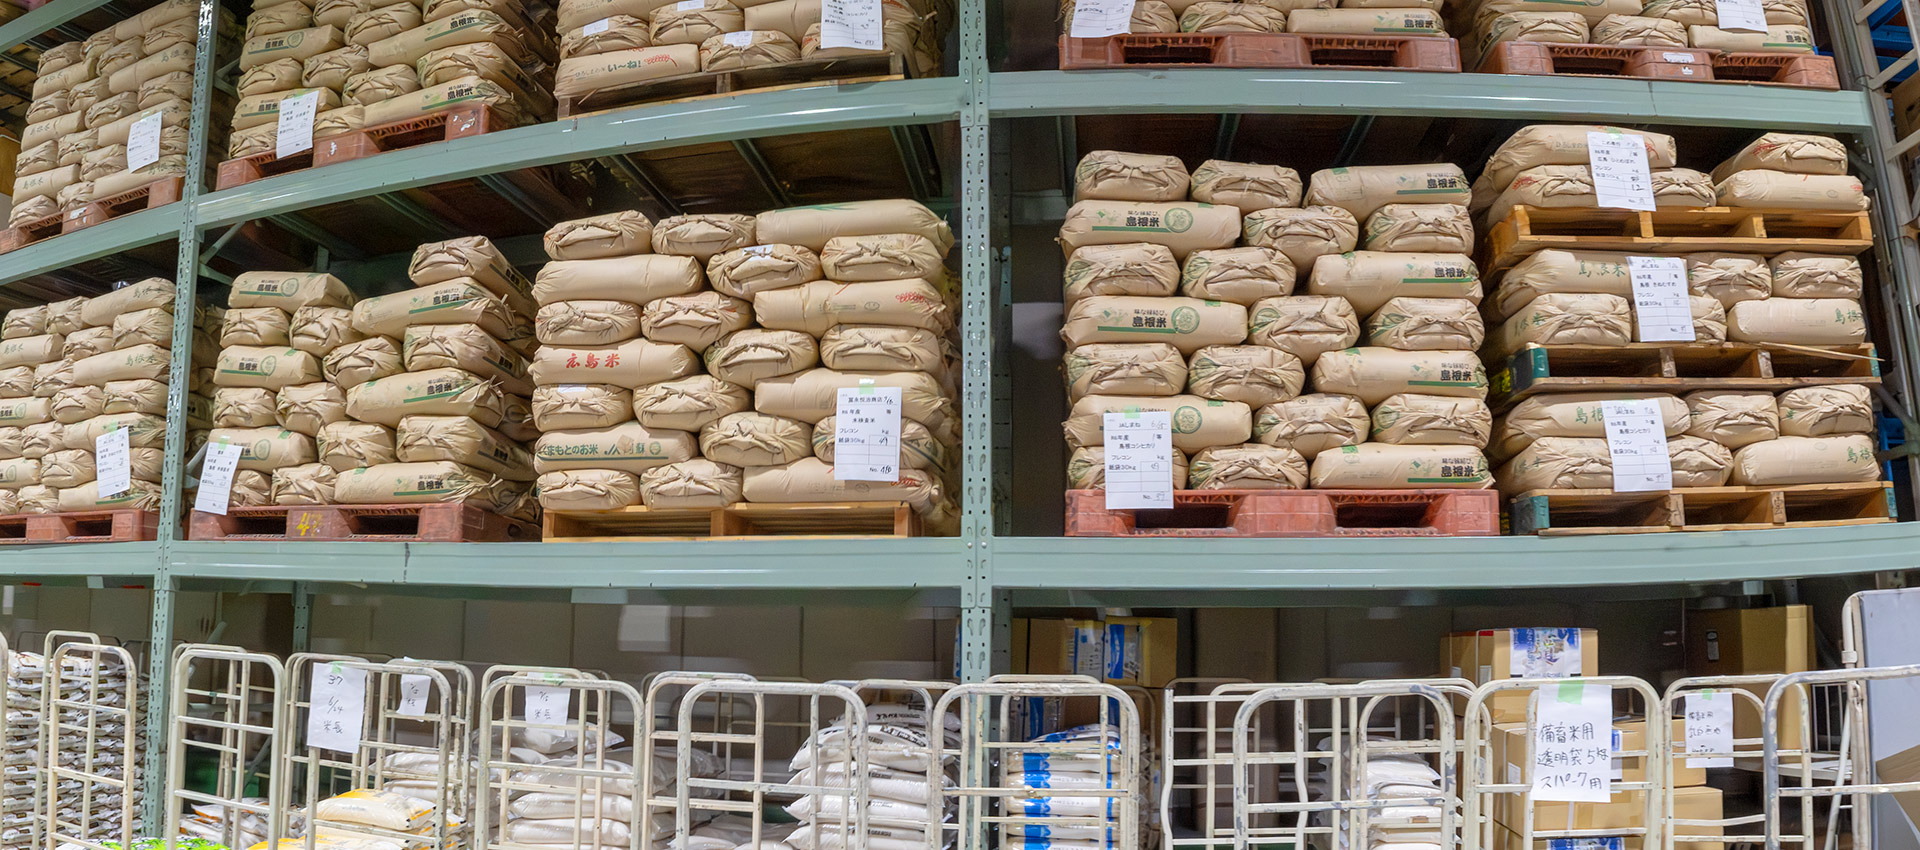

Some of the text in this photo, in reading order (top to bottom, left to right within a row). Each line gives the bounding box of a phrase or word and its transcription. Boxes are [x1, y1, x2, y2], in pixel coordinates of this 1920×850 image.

[1427, 178, 1457, 189] 島根米
[1125, 216, 1160, 227] 島根米
[1434, 267, 1466, 278] 島根米
[1132, 316, 1167, 328] 島根米
[566, 352, 620, 369] 広島米
[1440, 369, 1472, 381] 島根米
[1441, 465, 1475, 477] 島根米
[1540, 721, 1594, 743] 備蓄米用
